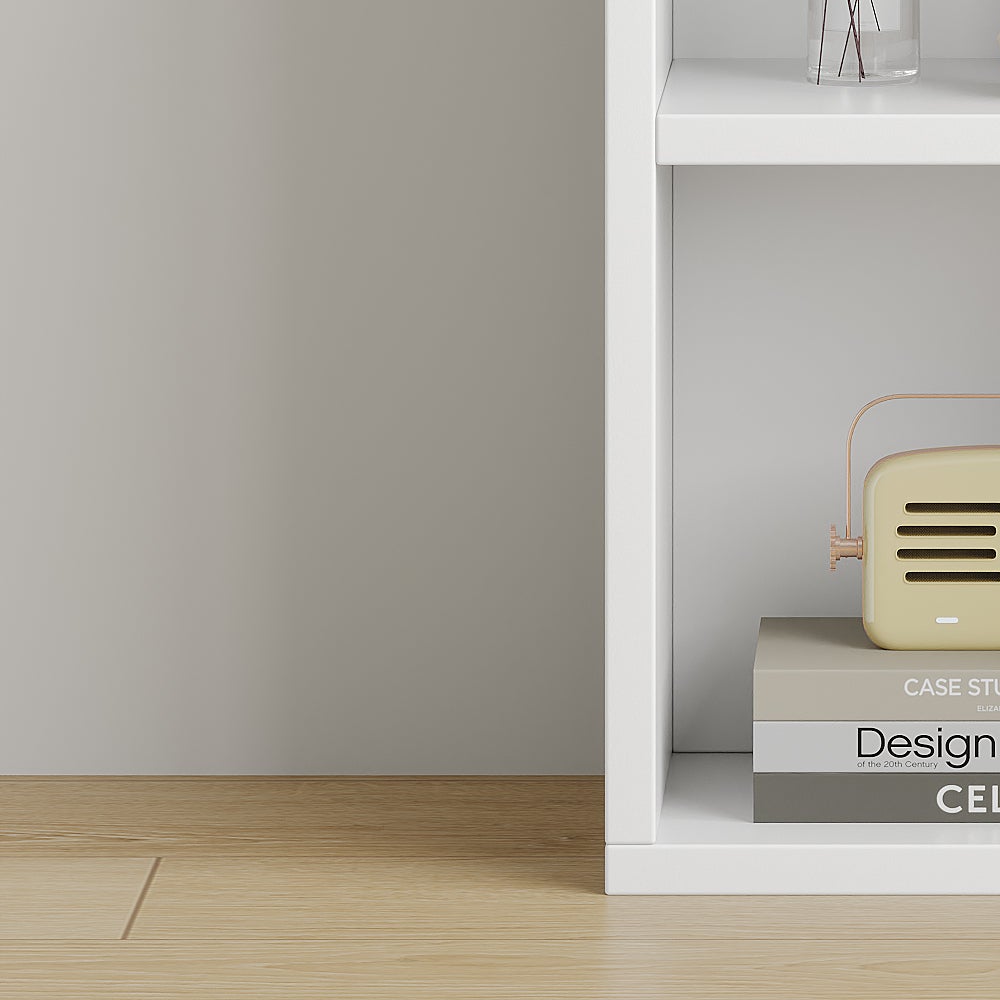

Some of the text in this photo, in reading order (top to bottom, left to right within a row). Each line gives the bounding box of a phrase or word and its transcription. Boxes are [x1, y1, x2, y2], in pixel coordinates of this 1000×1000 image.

[903, 678, 962, 697] CASE
[857, 727, 996, 769] Design
[857, 760, 939, 769] of the 20th Century
